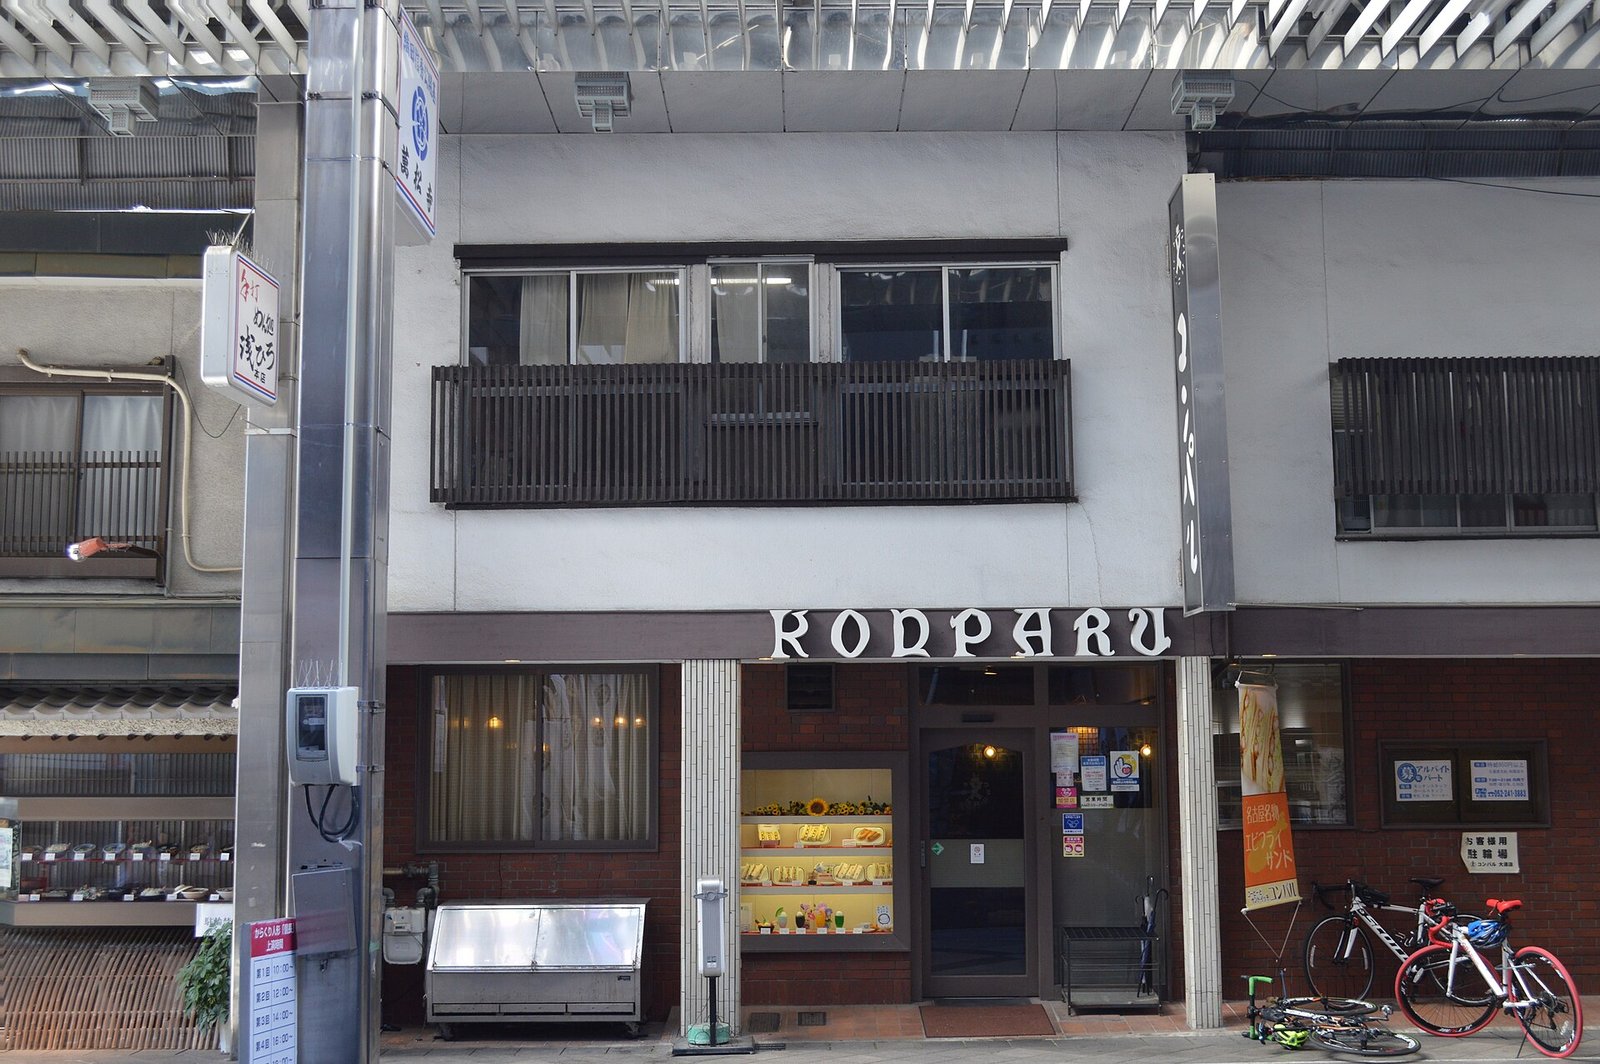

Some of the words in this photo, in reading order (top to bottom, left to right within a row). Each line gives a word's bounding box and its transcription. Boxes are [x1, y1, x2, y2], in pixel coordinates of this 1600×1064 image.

[254, 369, 266, 384] 本店
[1416, 765, 1450, 775] アルバイト
[1246, 804, 1280, 825] 名古屋名物
[1245, 829, 1283, 852] エビフライ
[1265, 850, 1293, 871] サンド
[1467, 849, 1508, 859] 駐輪場
[1268, 882, 1297, 901] コンパル
